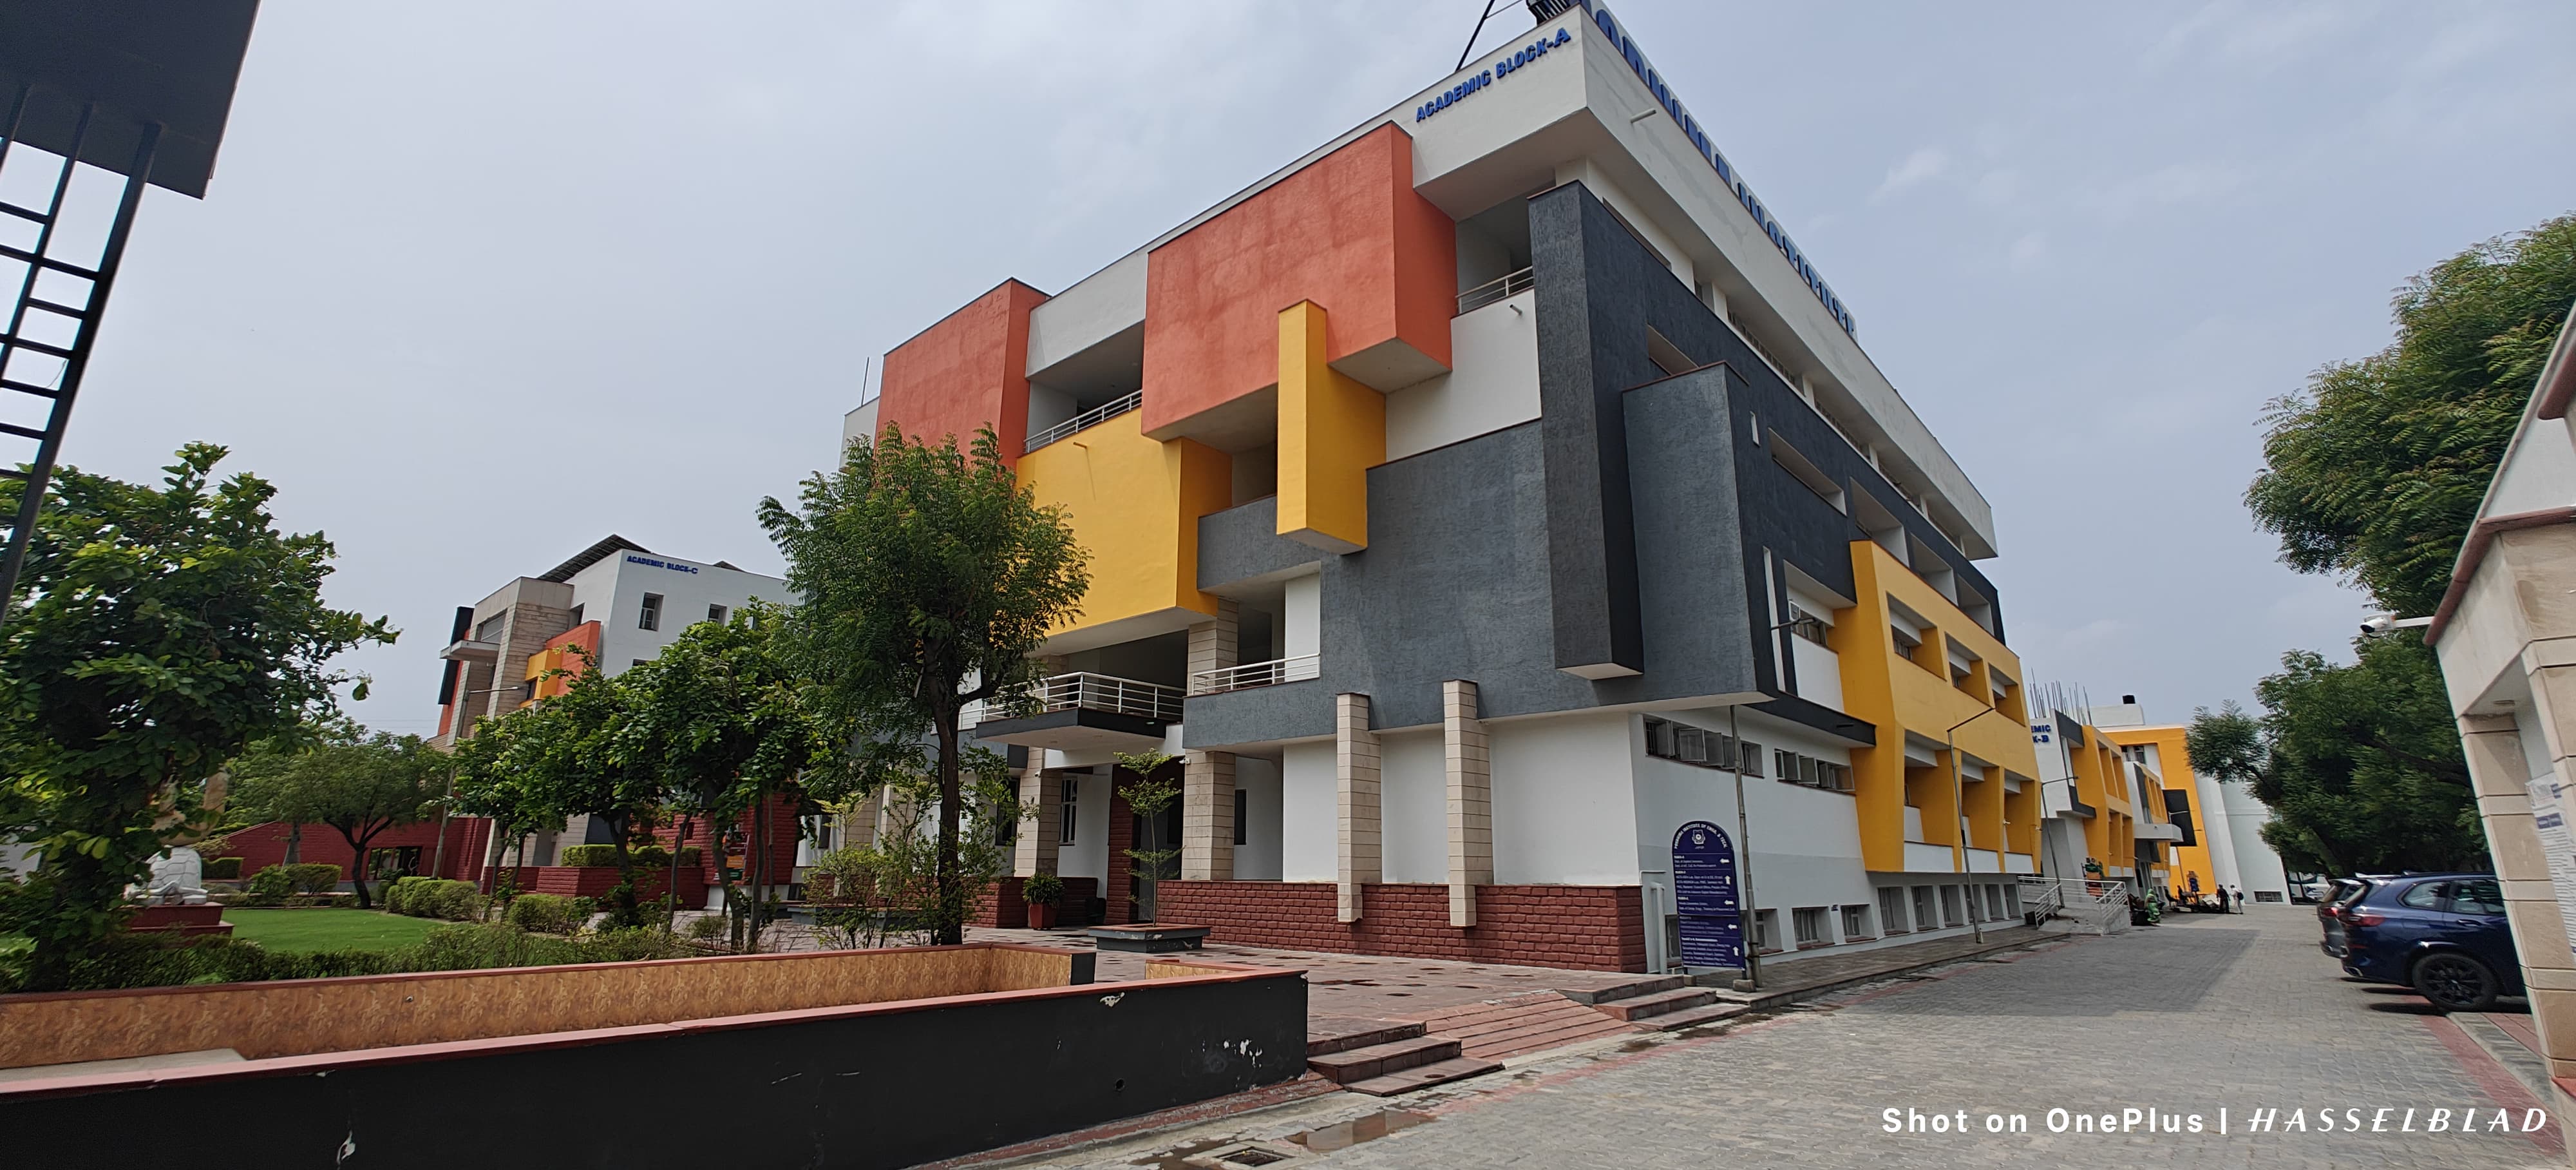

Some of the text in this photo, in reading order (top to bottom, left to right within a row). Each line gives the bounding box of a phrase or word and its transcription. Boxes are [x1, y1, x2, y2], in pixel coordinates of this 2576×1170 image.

[1416, 28, 1571, 122] ACADEMIC BLOCK-A
[627, 555, 698, 575] ACADEMIC BLOCK-C
